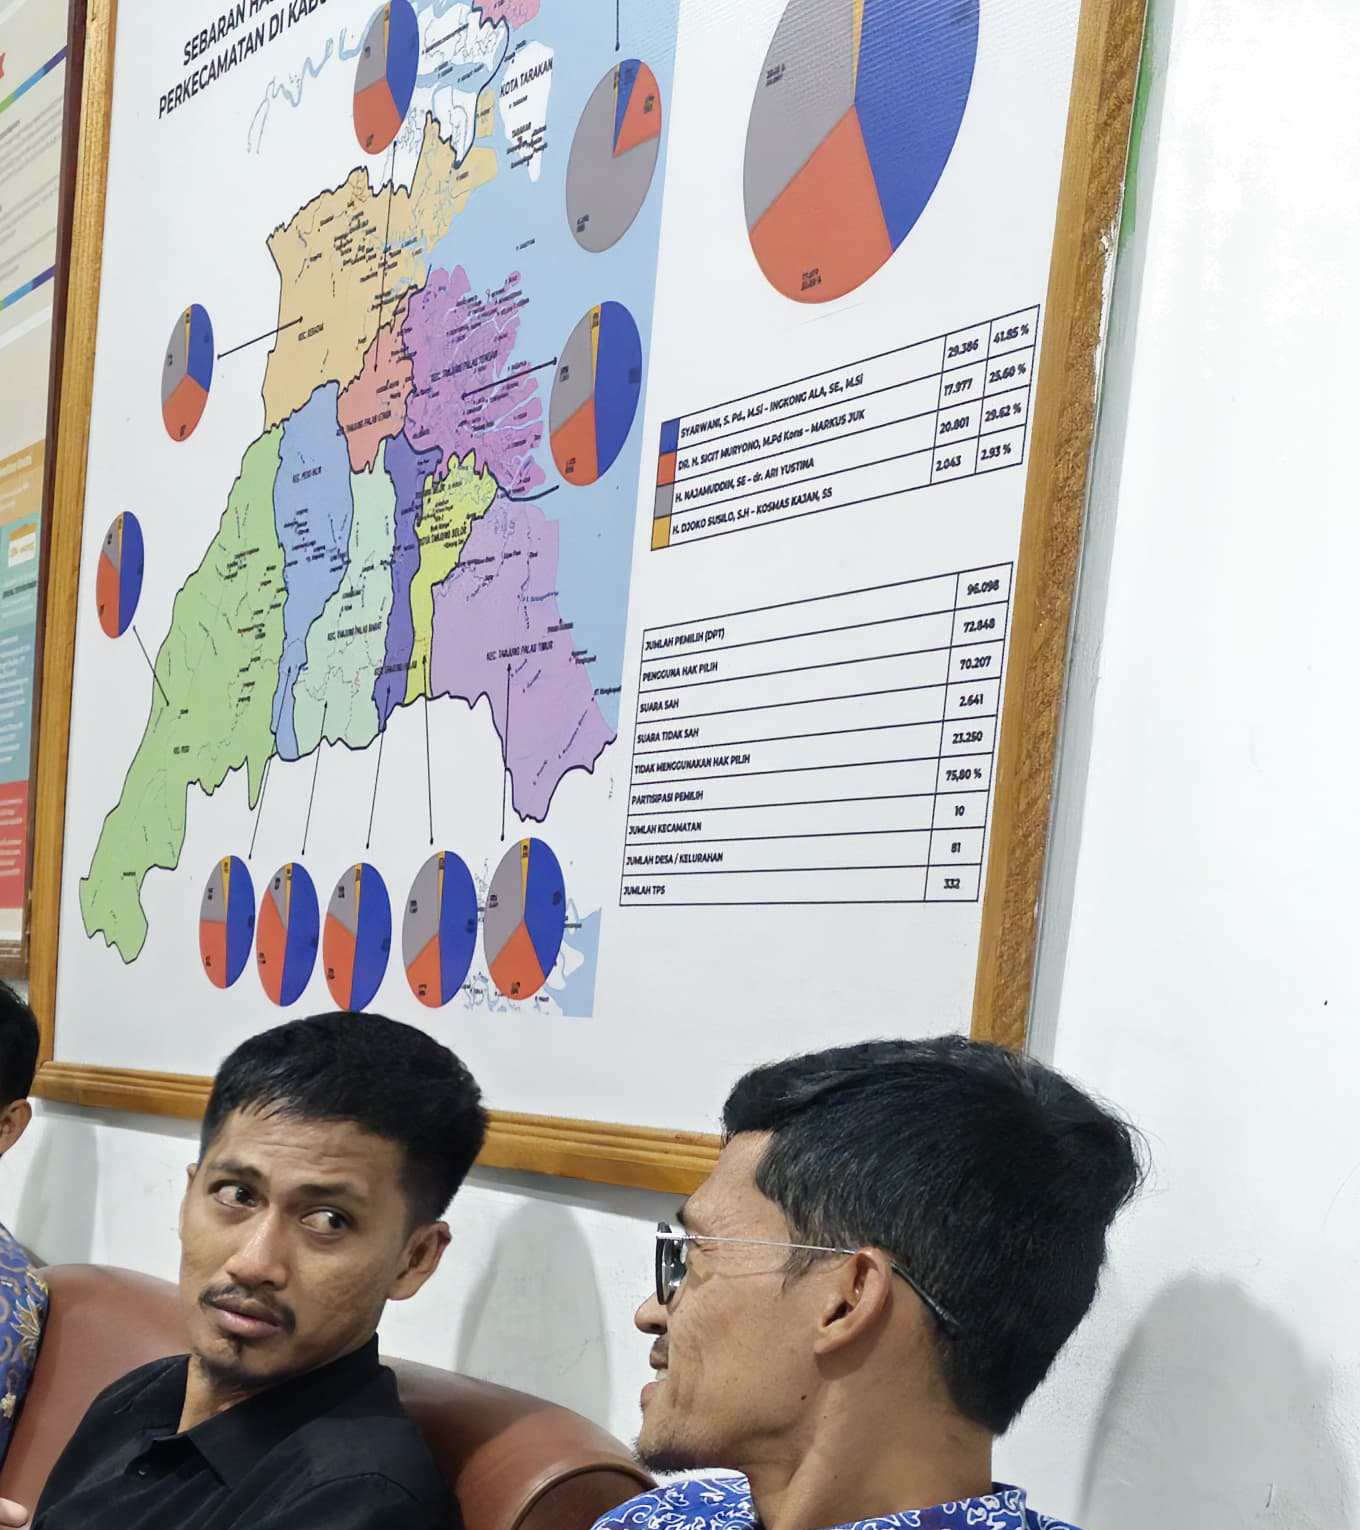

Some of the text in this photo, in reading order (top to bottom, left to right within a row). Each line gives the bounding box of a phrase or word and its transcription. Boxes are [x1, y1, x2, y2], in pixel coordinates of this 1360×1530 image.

[183, 5, 246, 66] SEBARAN
[158, 22, 265, 120] PERKECAMATAN
[268, 8, 284, 43] DI
[810, 414, 846, 433] MARKUS
[939, 416, 970, 435] 20.801
[764, 466, 779, 480] ARI
[756, 497, 789, 515] KOSMAS
[681, 664, 698, 675] HAK
[959, 655, 991, 670] 70.207
[664, 698, 679, 709] SAH
[662, 729, 683, 741] TIDAK
[684, 727, 699, 738] SAH
[634, 763, 655, 775] TIDAK
[713, 755, 729, 767] HAK
[954, 805, 965, 817] 10
[652, 884, 666, 895] TPS
